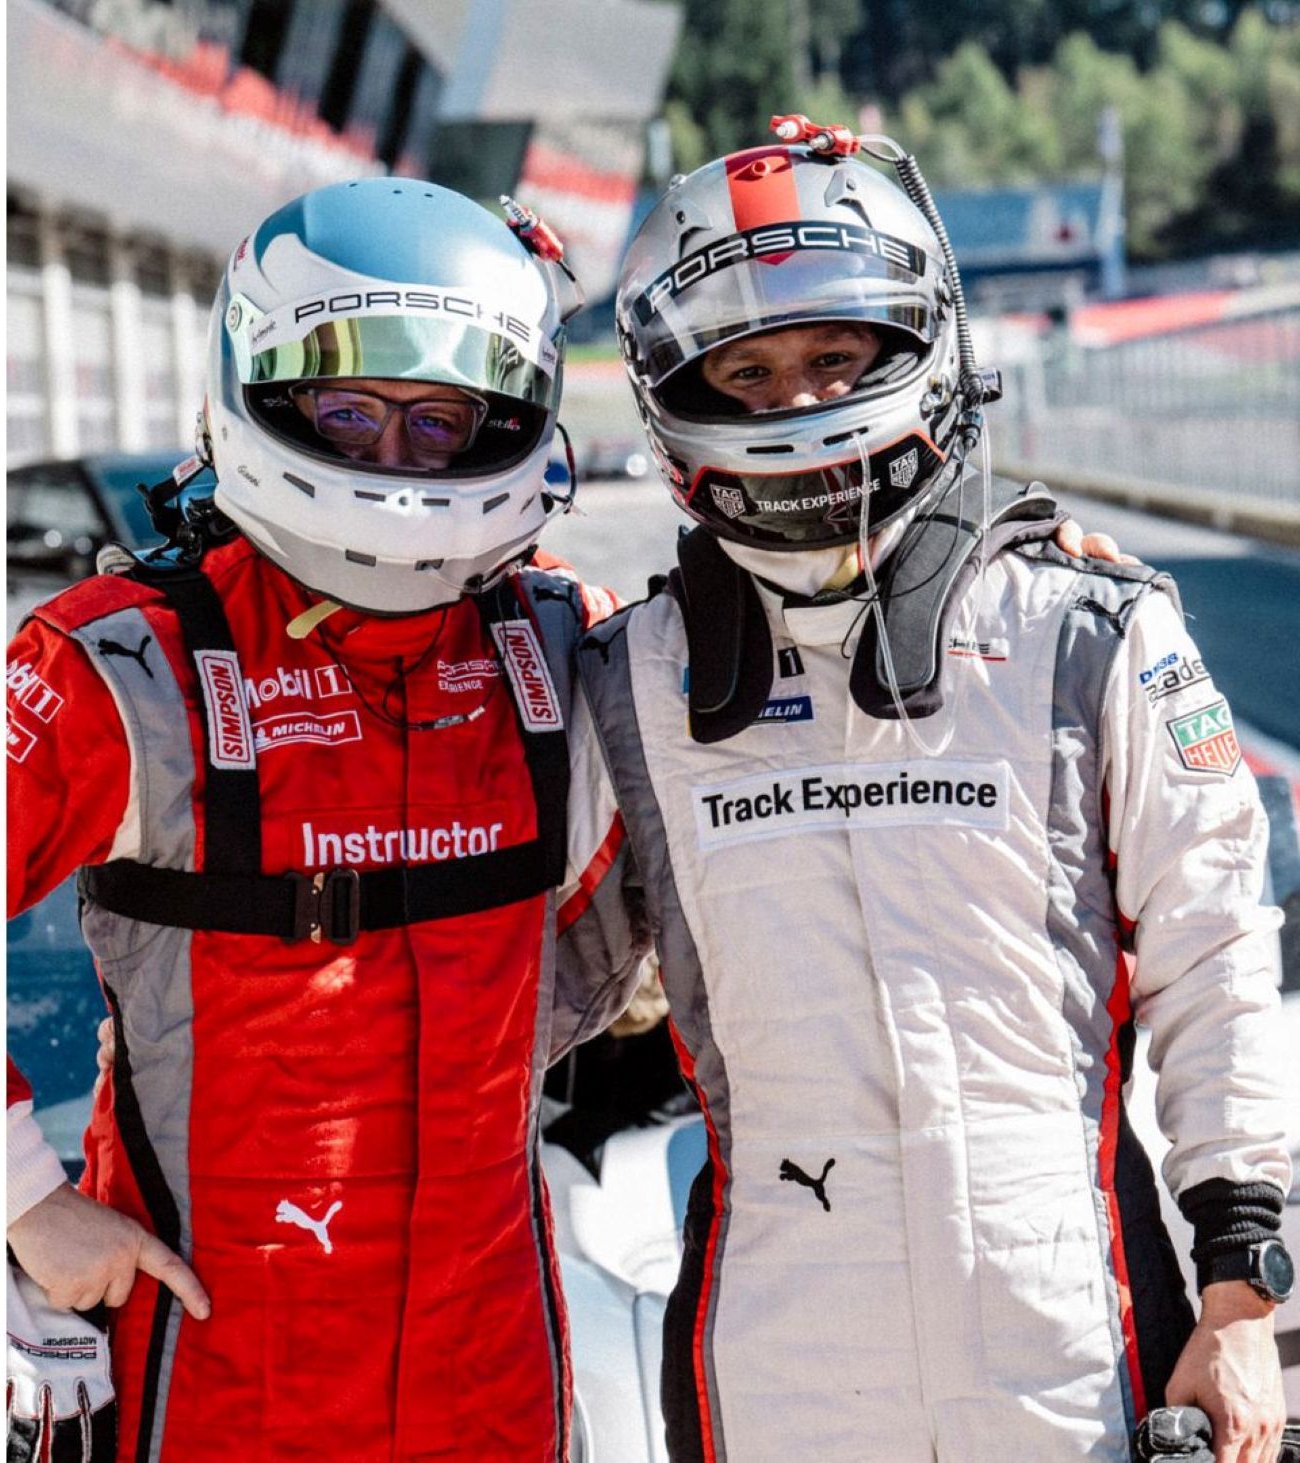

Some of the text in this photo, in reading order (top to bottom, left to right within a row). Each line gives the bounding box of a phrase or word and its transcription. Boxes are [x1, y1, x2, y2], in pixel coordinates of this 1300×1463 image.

[650, 227, 912, 314] PORSCHE
[294, 291, 530, 343] PORSCHE
[892, 452, 914, 472] TAG
[713, 487, 740, 501] TAG
[757, 478, 881, 513] TRACK EXPERIENCE
[505, 634, 553, 720] SIMPSON
[784, 650, 798, 675] 1
[209, 664, 244, 758] SIMPSON
[271, 721, 346, 738] MICHELIN
[701, 772, 998, 829] Track Experience
[302, 821, 504, 868] Instructor
